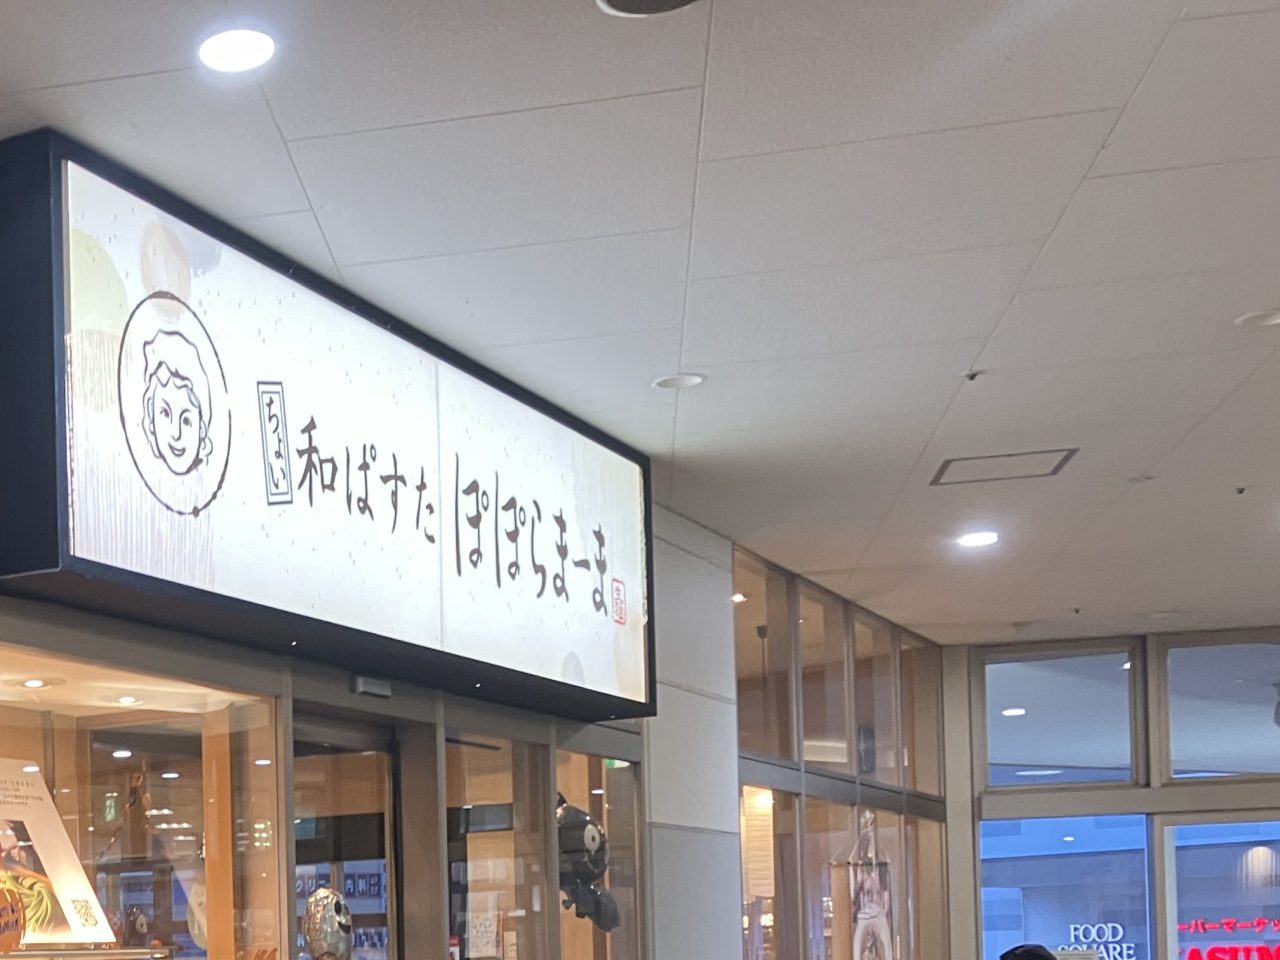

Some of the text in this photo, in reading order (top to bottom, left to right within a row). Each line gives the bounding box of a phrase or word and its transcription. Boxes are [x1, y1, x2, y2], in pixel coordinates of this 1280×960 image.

[266, 396, 287, 490] ちょい
[296, 415, 608, 617] 和ぱすた ぽぽらまーま
[1070, 923, 1124, 943] FOOD
